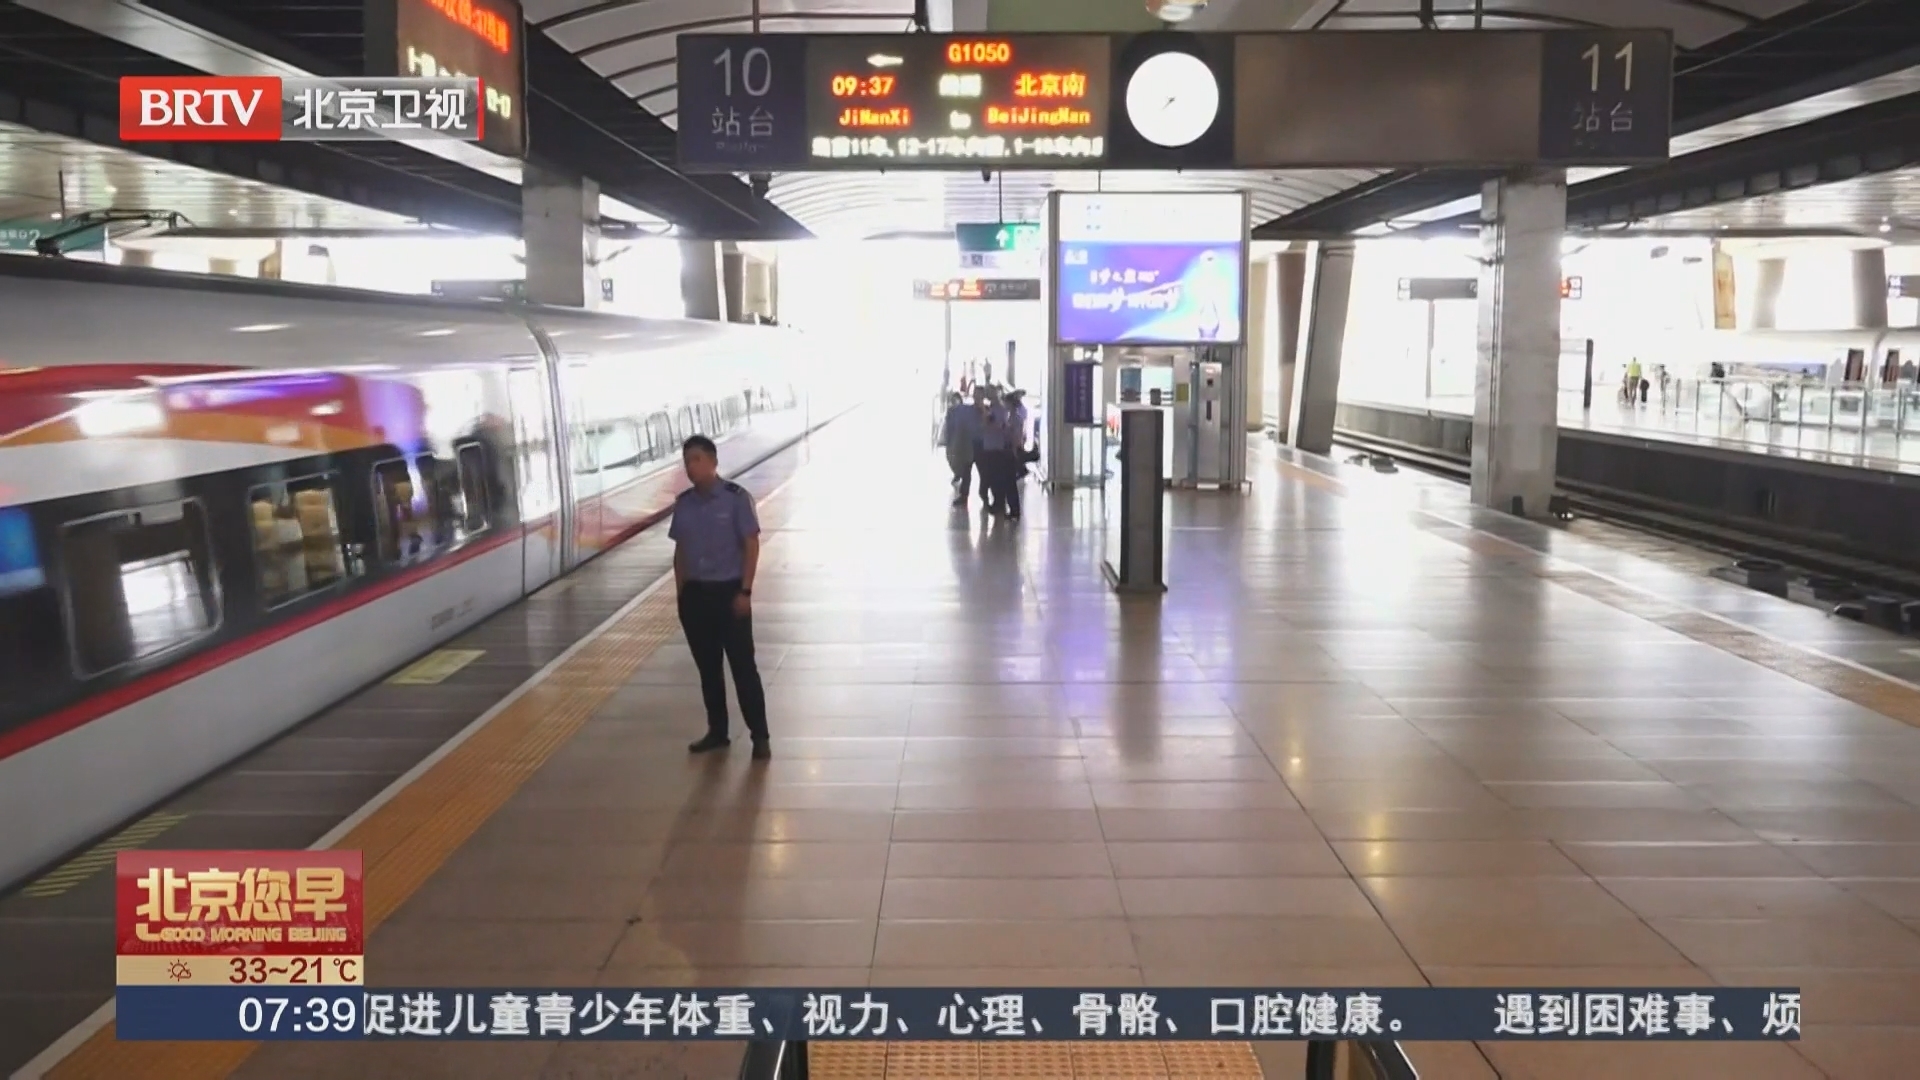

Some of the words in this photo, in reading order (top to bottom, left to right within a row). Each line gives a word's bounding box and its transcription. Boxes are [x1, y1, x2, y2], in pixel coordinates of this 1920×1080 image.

[947, 43, 1009, 63] G1050
[1581, 42, 1633, 91] 11
[713, 47, 772, 96] 10
[832, 75, 895, 96] 09:37
[1014, 73, 1086, 97] 北京南
[711, 105, 774, 136] 站台
[839, 108, 909, 126] JiNanXi
[987, 107, 1091, 125] BeiJingNan
